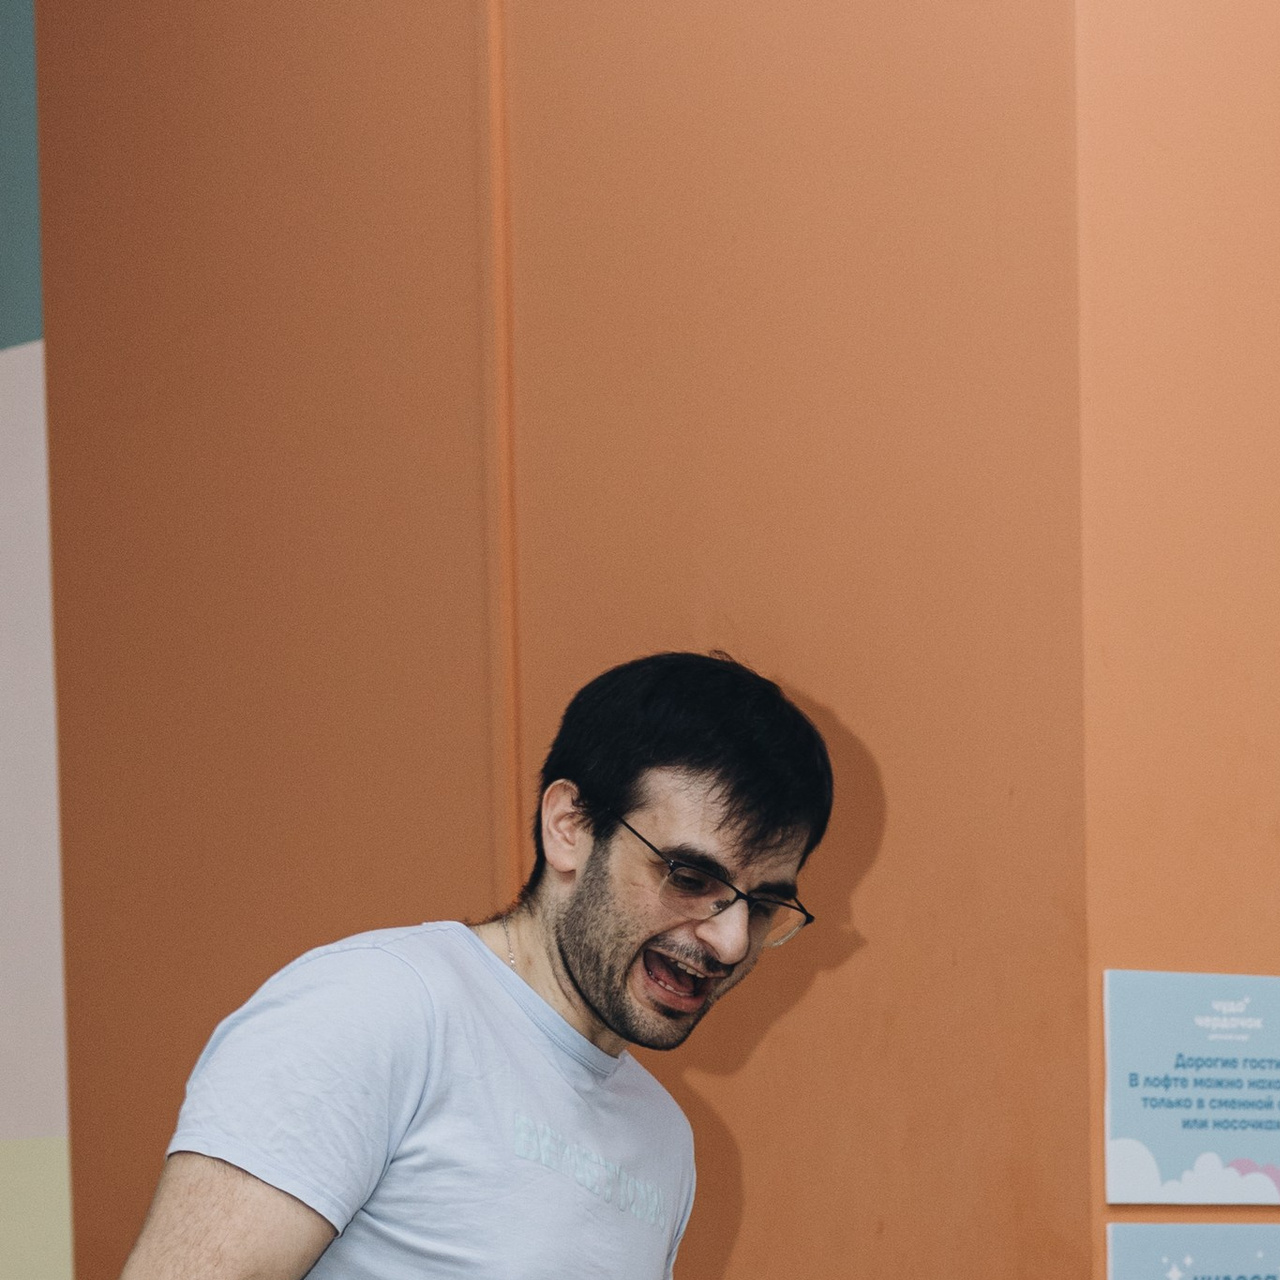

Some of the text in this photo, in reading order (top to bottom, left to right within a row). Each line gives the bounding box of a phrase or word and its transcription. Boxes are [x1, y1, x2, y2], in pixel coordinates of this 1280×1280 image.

[1174, 1053, 1238, 1071] Дорогие
[1128, 1073, 1138, 1087] В
[1143, 1074, 1189, 1092] лофте
[1193, 1077, 1243, 1090] можно
[1141, 1096, 1192, 1110] только
[1197, 1098, 1205, 1109] в
[1209, 1095, 1274, 1111] сменной
[1181, 1118, 1208, 1130] или
